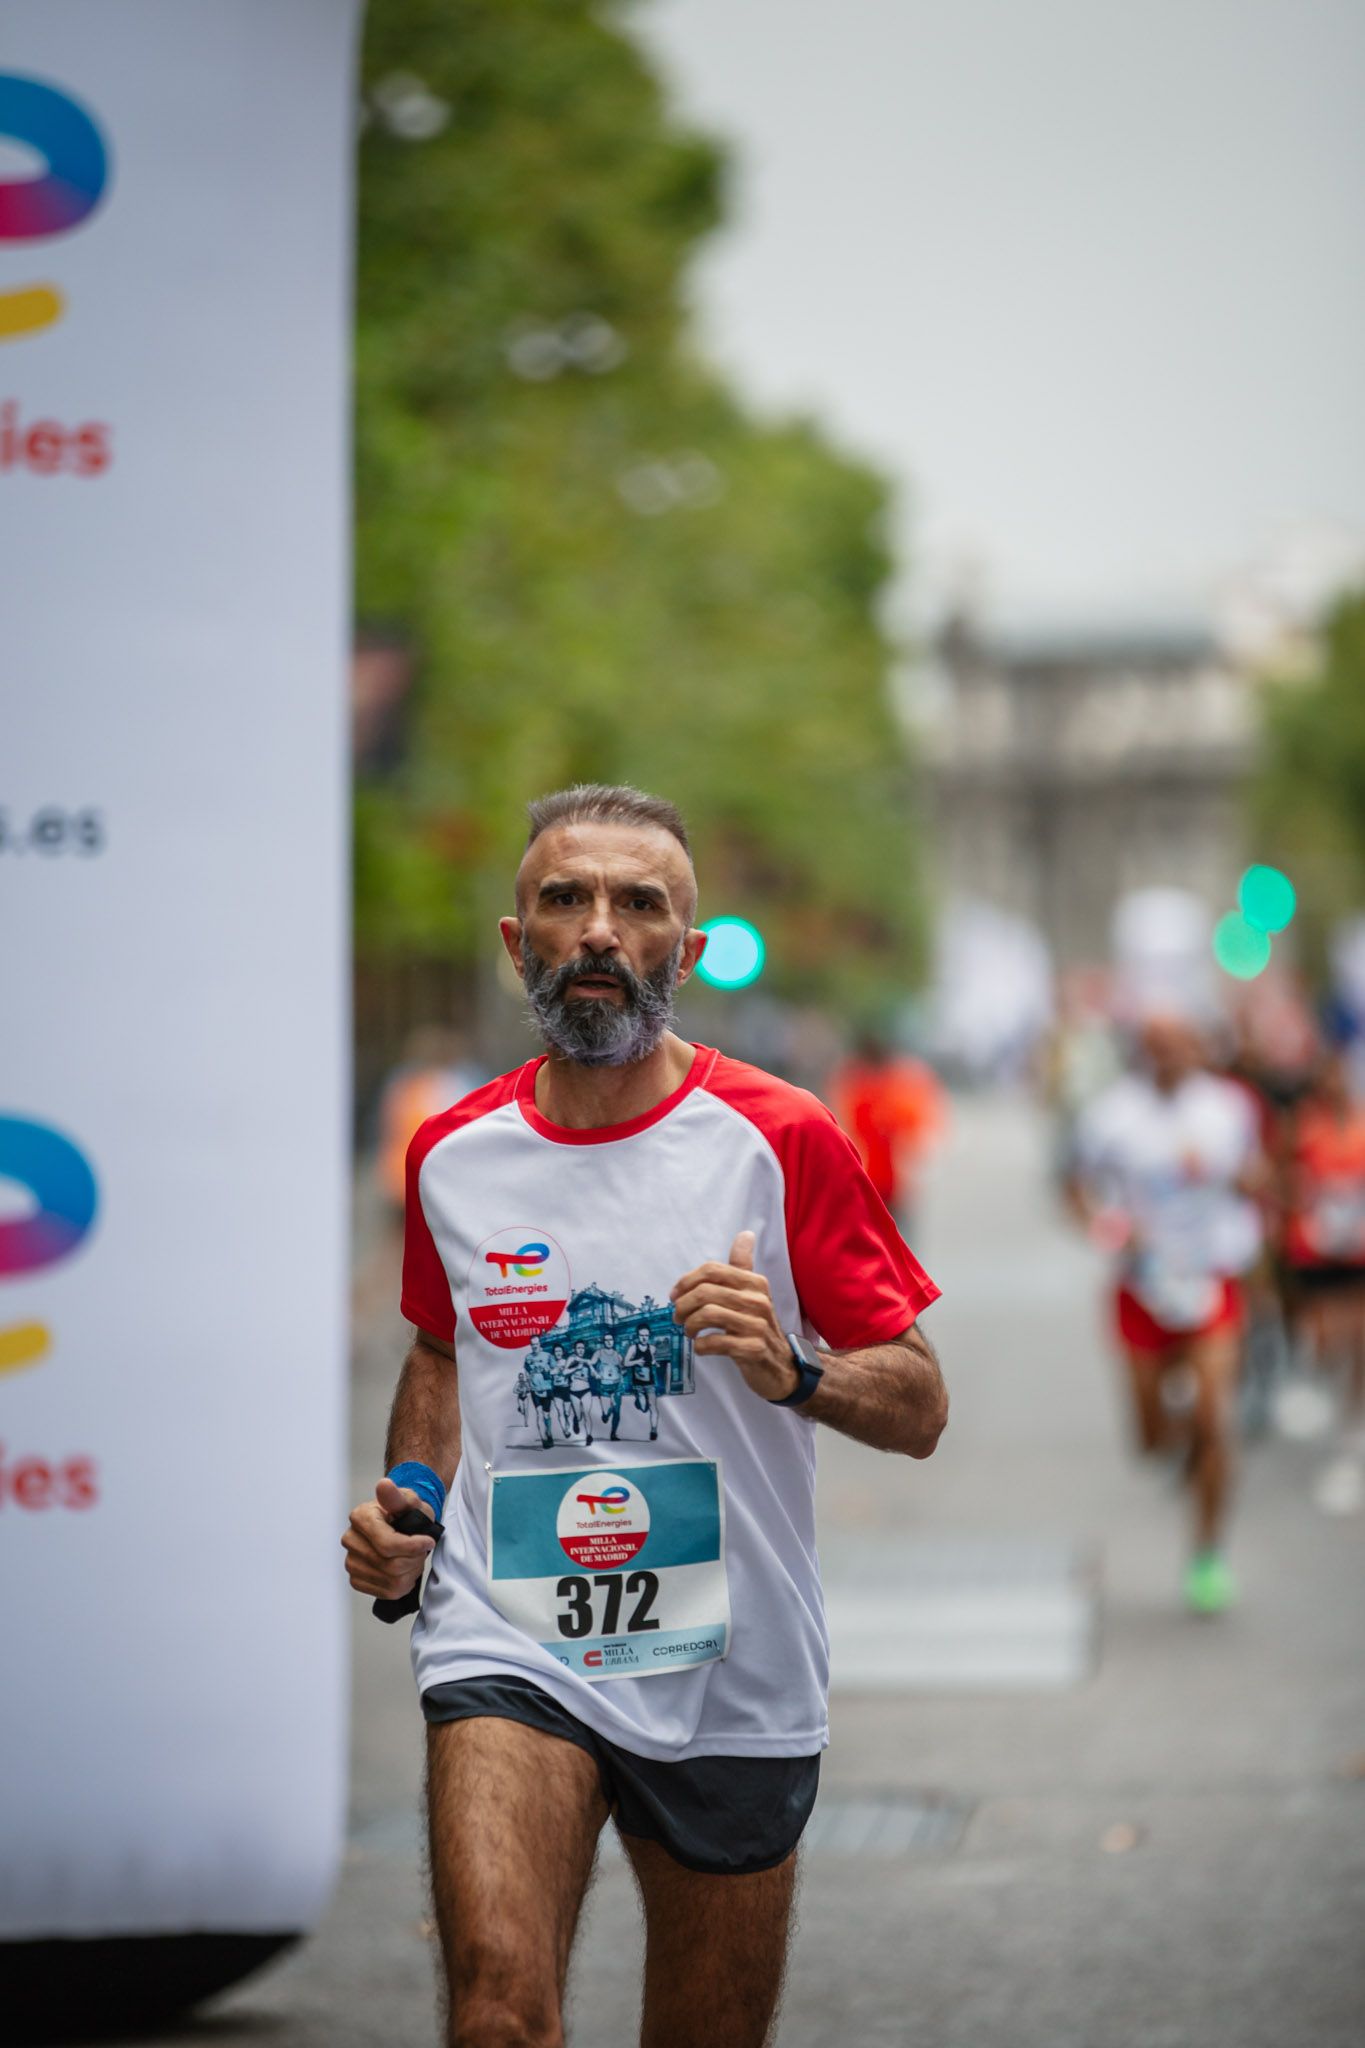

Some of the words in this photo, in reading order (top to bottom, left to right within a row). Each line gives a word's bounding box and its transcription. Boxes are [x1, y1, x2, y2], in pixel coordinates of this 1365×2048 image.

[484, 1284, 548, 1296] TotalEnergies
[499, 1306, 528, 1316] MILLA
[480, 1316, 552, 1329] INTERNACIONAL
[490, 1330, 502, 1340] DE
[503, 1327, 540, 1338] MADRID
[576, 1519, 632, 1530] TotalEnergies
[589, 1536, 618, 1546] MILLA
[570, 1544, 638, 1555] INTERNACIONAL
[580, 1555, 593, 1563] DE
[594, 1552, 629, 1562] MADRID
[556, 1571, 660, 1639] 372
[604, 1647, 634, 1657] MILLA
[604, 1655, 640, 1666] URBANA
